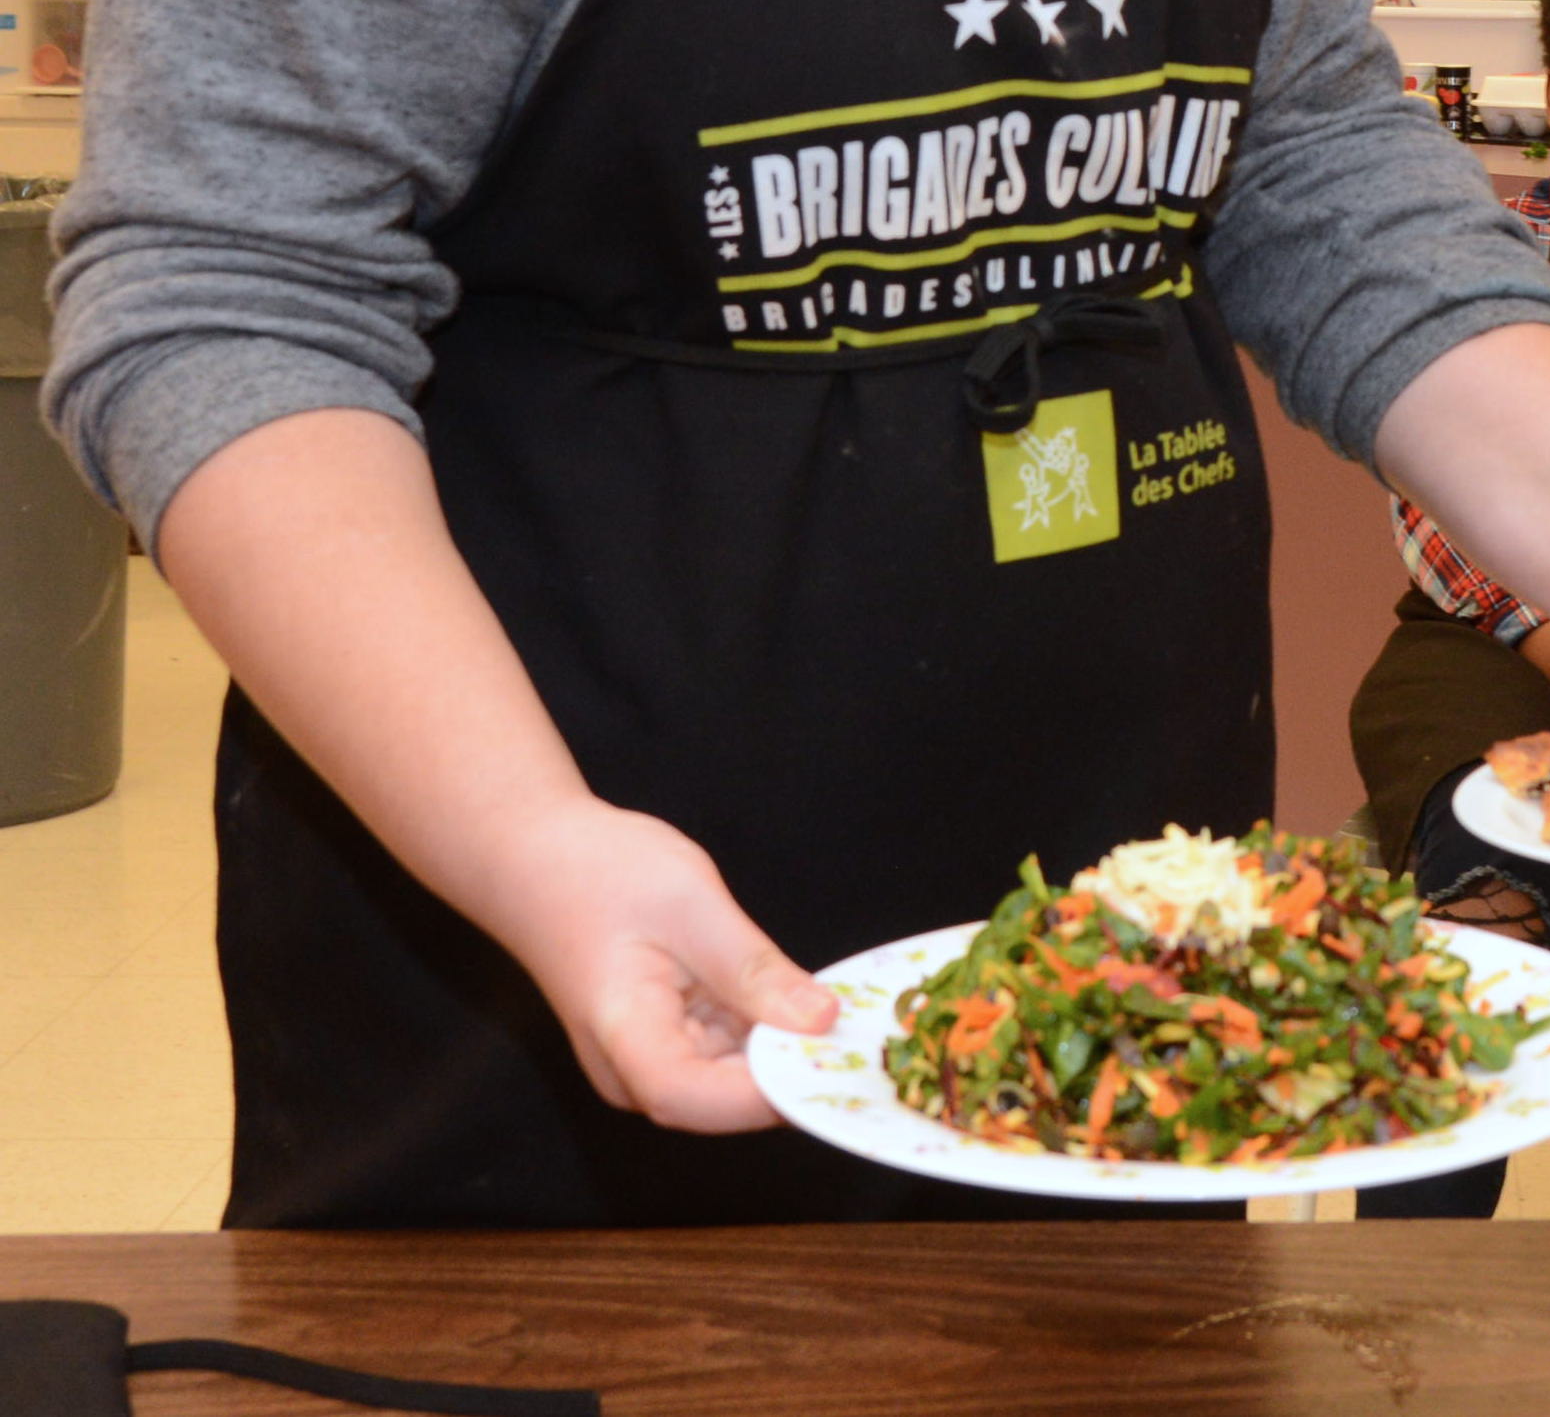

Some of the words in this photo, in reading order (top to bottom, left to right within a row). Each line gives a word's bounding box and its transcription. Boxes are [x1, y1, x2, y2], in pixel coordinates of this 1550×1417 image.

[704, 186, 744, 238] LES
[752, 109, 1032, 259] BRIGADES
[1128, 440, 1158, 470] La
[1156, 419, 1227, 462] Tablée
[1131, 474, 1175, 507] des
[1178, 451, 1236, 495] Chefs
